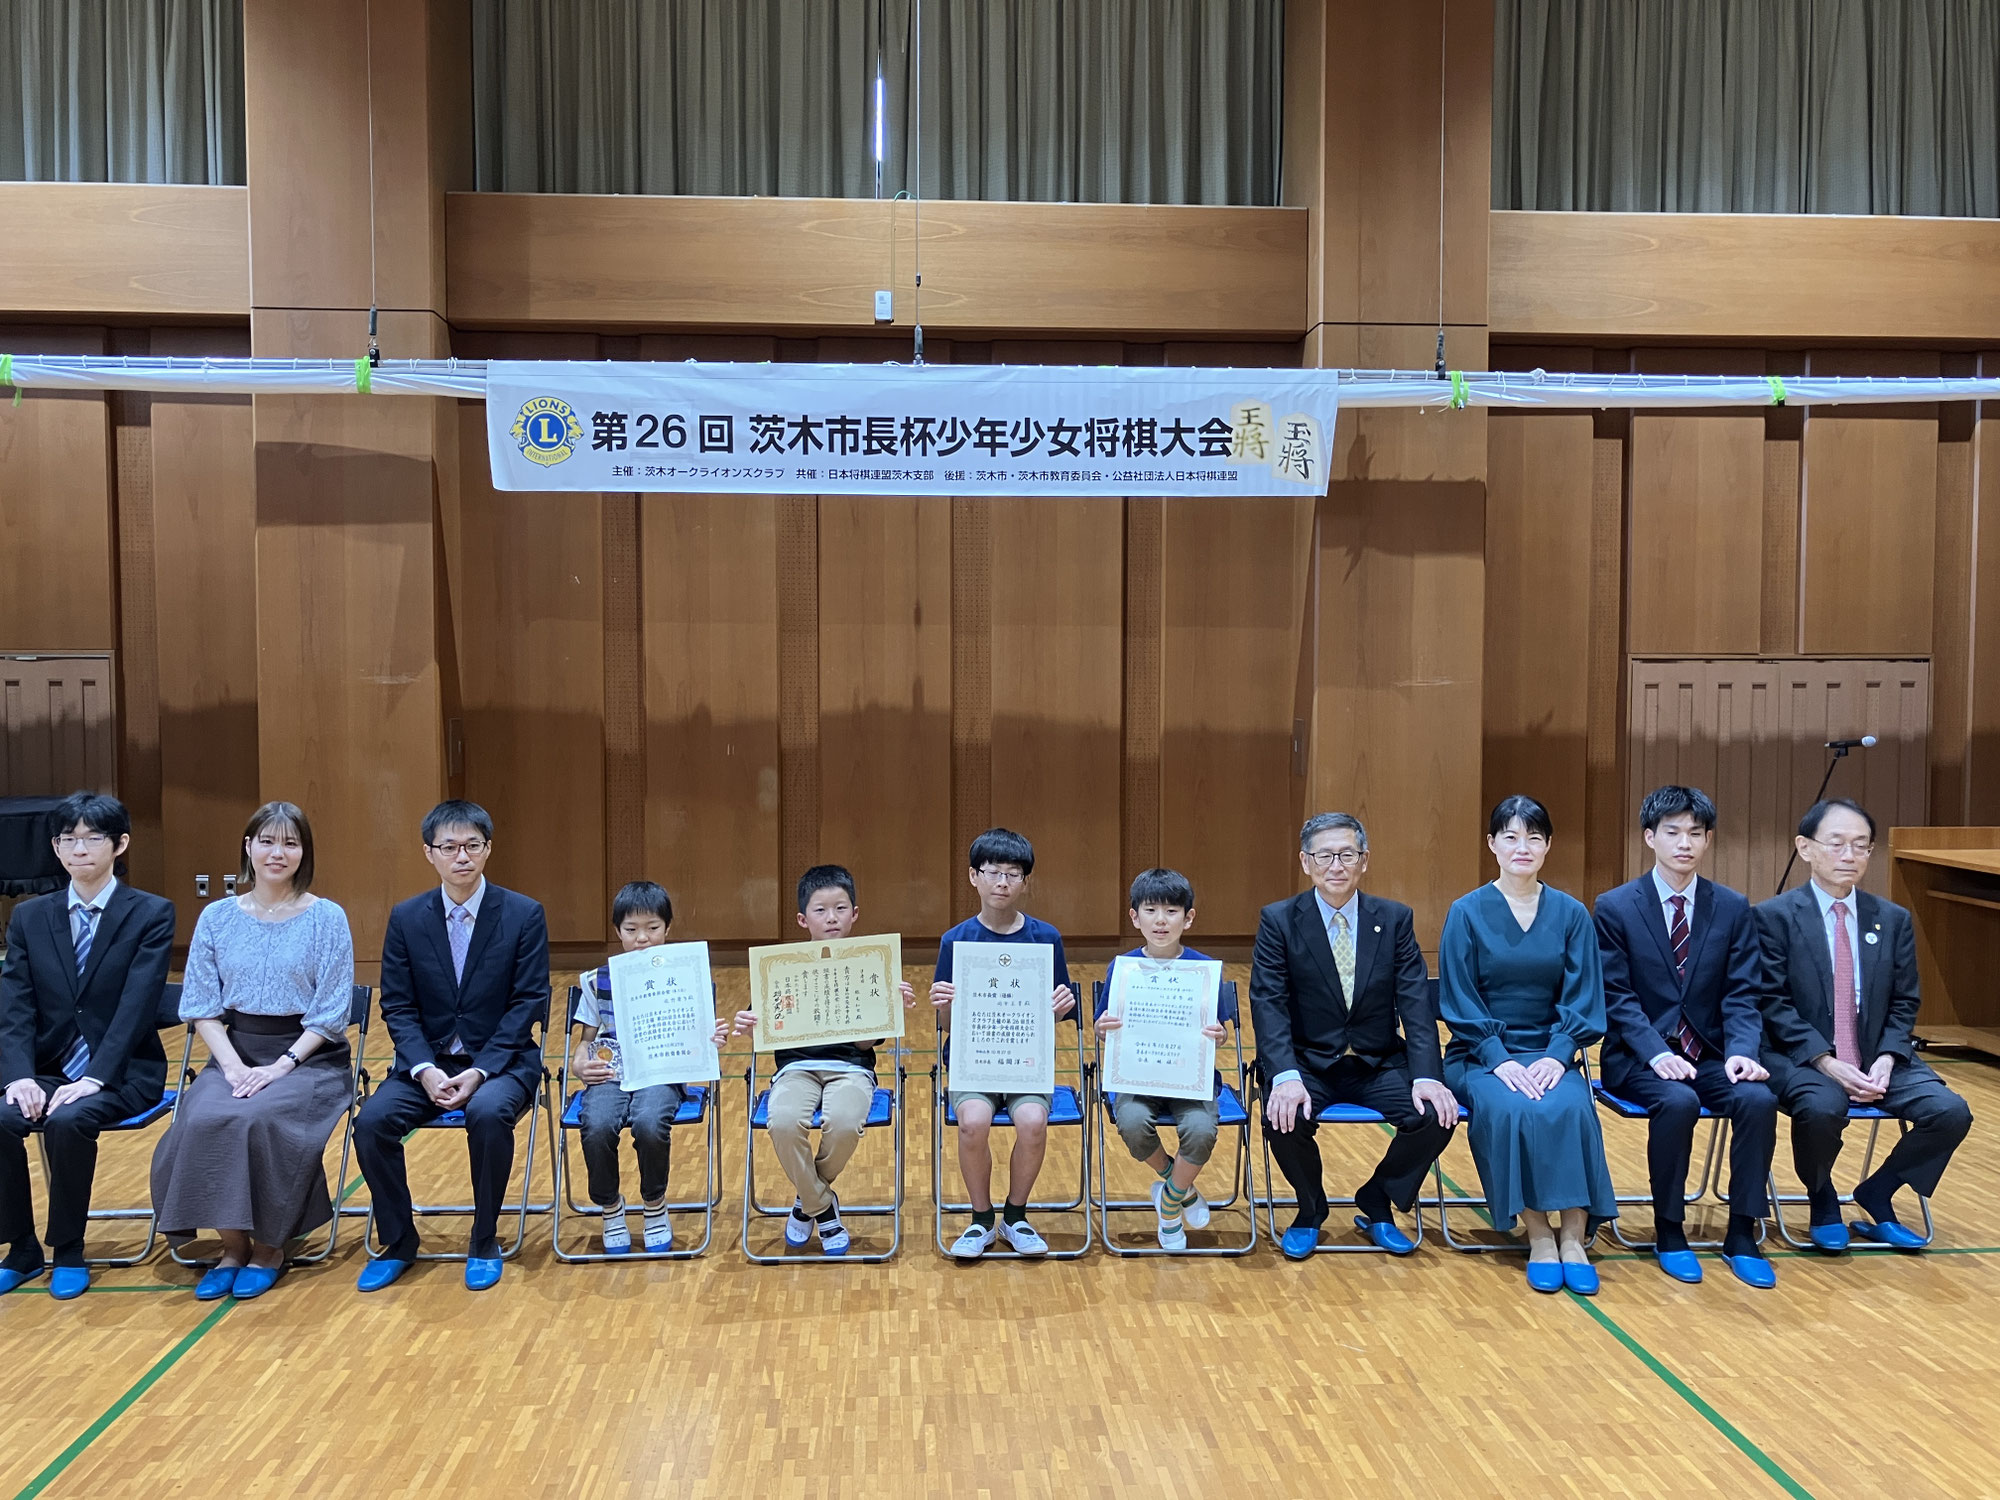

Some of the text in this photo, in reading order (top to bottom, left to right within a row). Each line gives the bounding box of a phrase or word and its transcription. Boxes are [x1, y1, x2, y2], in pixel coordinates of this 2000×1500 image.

[525, 400, 568, 414] LIONS
[538, 418, 558, 442] L
[749, 415, 1234, 458] 茨木市長杯少年少女将棋大会
[526, 448, 568, 461] INTERNATIONAL
[612, 466, 785, 479] 主催：茨木オークライオンズクラブ
[796, 468, 935, 481] 共催：日本将棋連盟茨木支部
